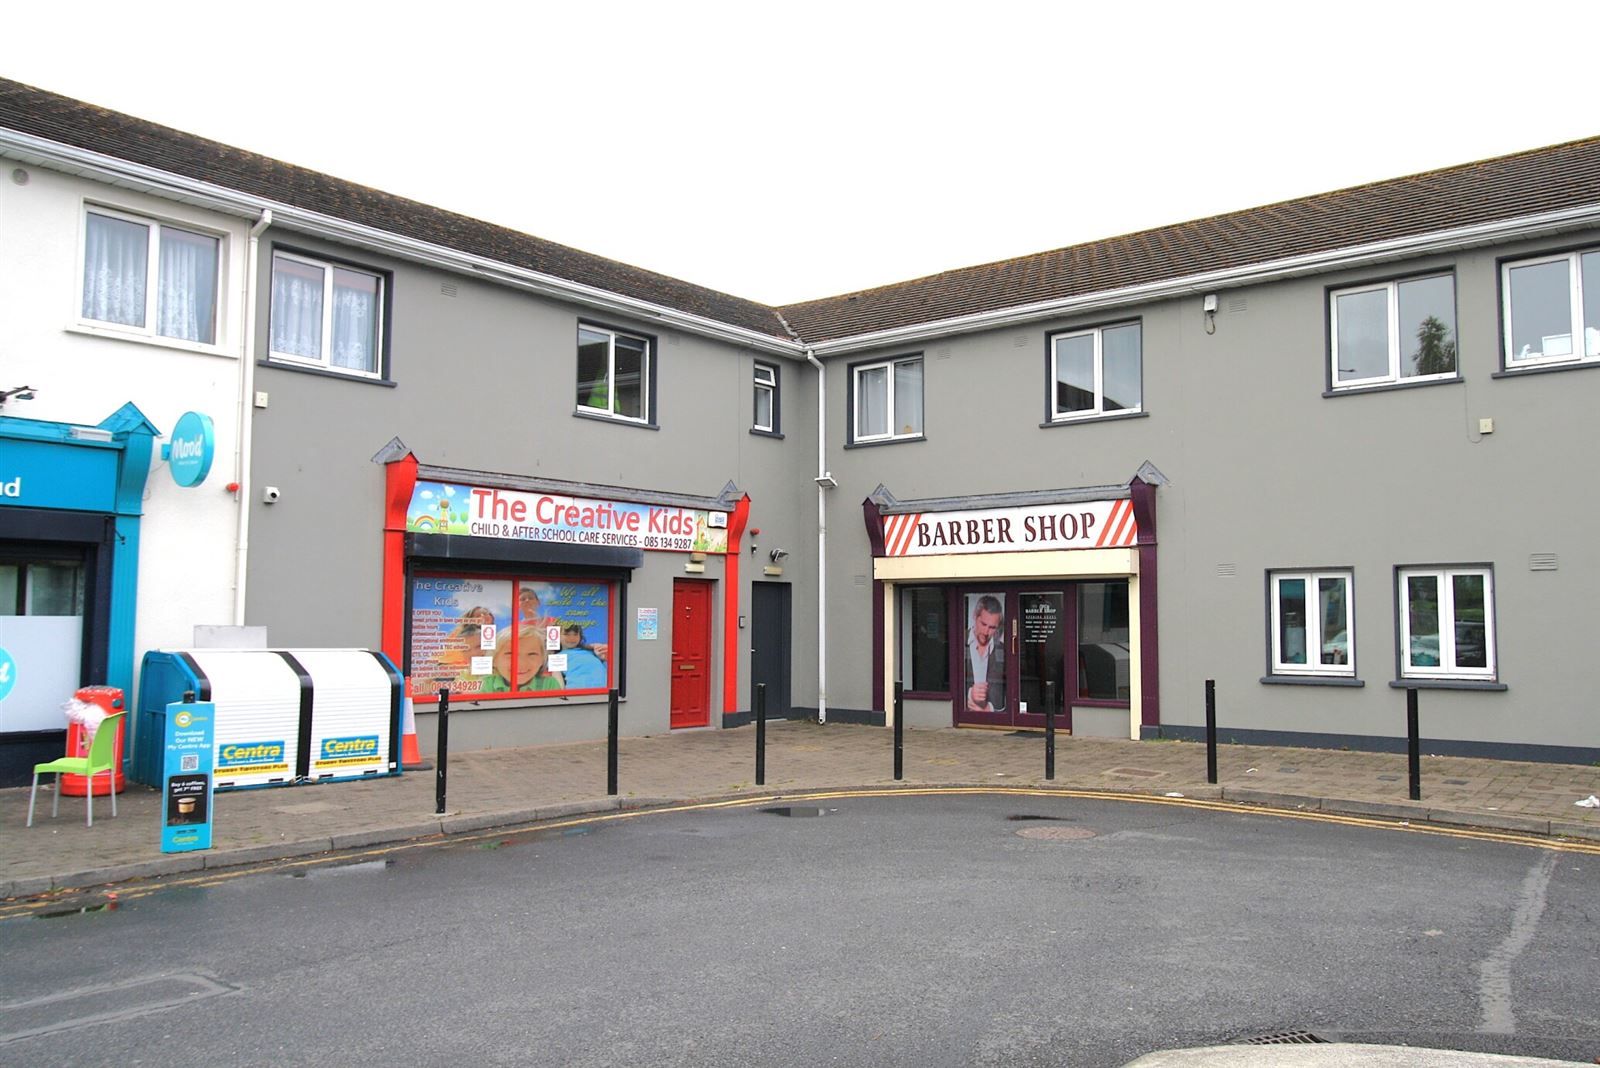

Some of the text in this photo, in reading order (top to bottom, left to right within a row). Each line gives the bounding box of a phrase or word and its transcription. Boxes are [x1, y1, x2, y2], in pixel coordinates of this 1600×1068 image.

[173, 433, 203, 459] Mood
[472, 489, 693, 536] The Creative Kids
[471, 522, 500, 536] CHILD
[502, 524, 510, 537] &
[512, 525, 540, 539] AFTER
[542, 528, 577, 542] SCHOOL
[578, 531, 600, 544] CARE
[602, 532, 637, 546] SERVICES
[644, 537, 658, 547] 085
[660, 537, 672, 548] 134
[674, 538, 692, 549] 9287
[917, 512, 1096, 547] BARBER SHOP
[434, 581, 484, 592] Creative
[434, 596, 459, 607] Kids
[223, 744, 281, 760] Centra
[324, 739, 376, 753] Centra
